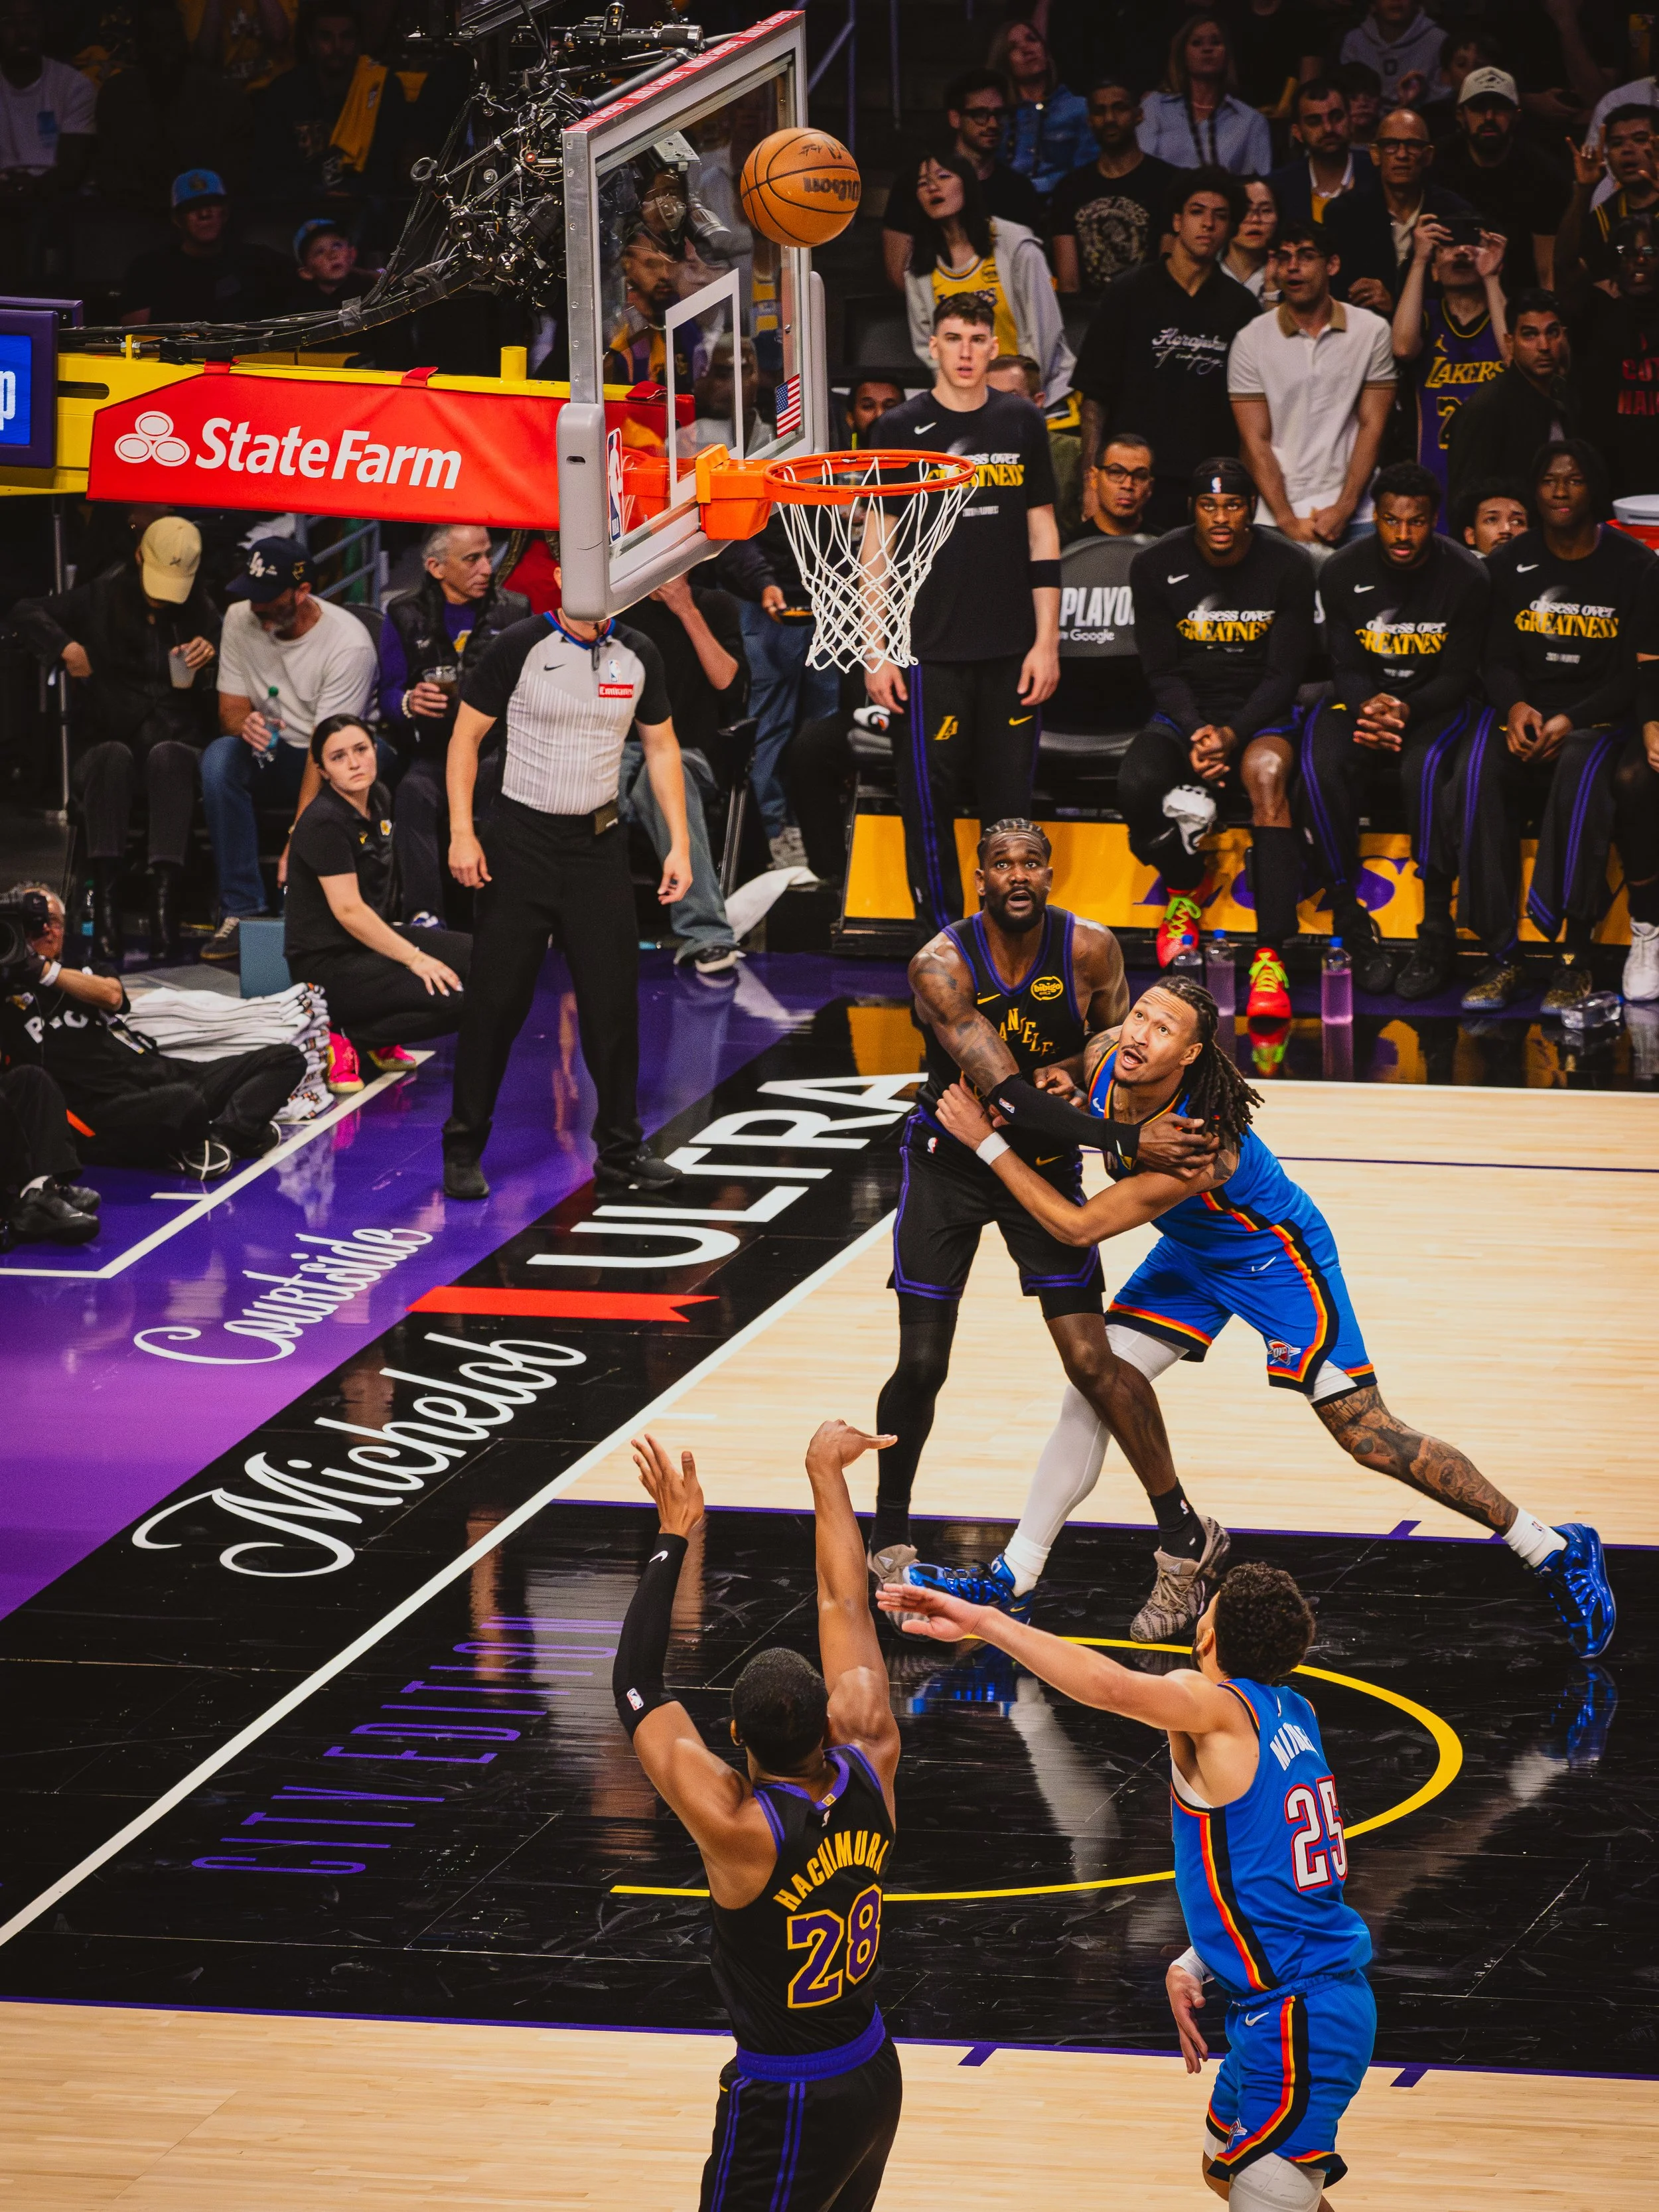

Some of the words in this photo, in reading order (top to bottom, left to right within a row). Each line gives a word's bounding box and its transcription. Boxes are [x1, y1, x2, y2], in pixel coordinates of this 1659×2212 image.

[1060, 586, 1135, 627] PLAYO
[1069, 628, 1116, 644] Google
[1514, 609, 1620, 638] GREATNESS
[132, 1333, 587, 1577] Michelob
[526, 1072, 929, 1268] ULTRA
[134, 1226, 433, 1364] Courtside
[191, 1785, 445, 1874] CITY
[772, 1830, 890, 1912] HACHIMURA
[1284, 1774, 1348, 1893] 25
[787, 1883, 883, 2010] 28
